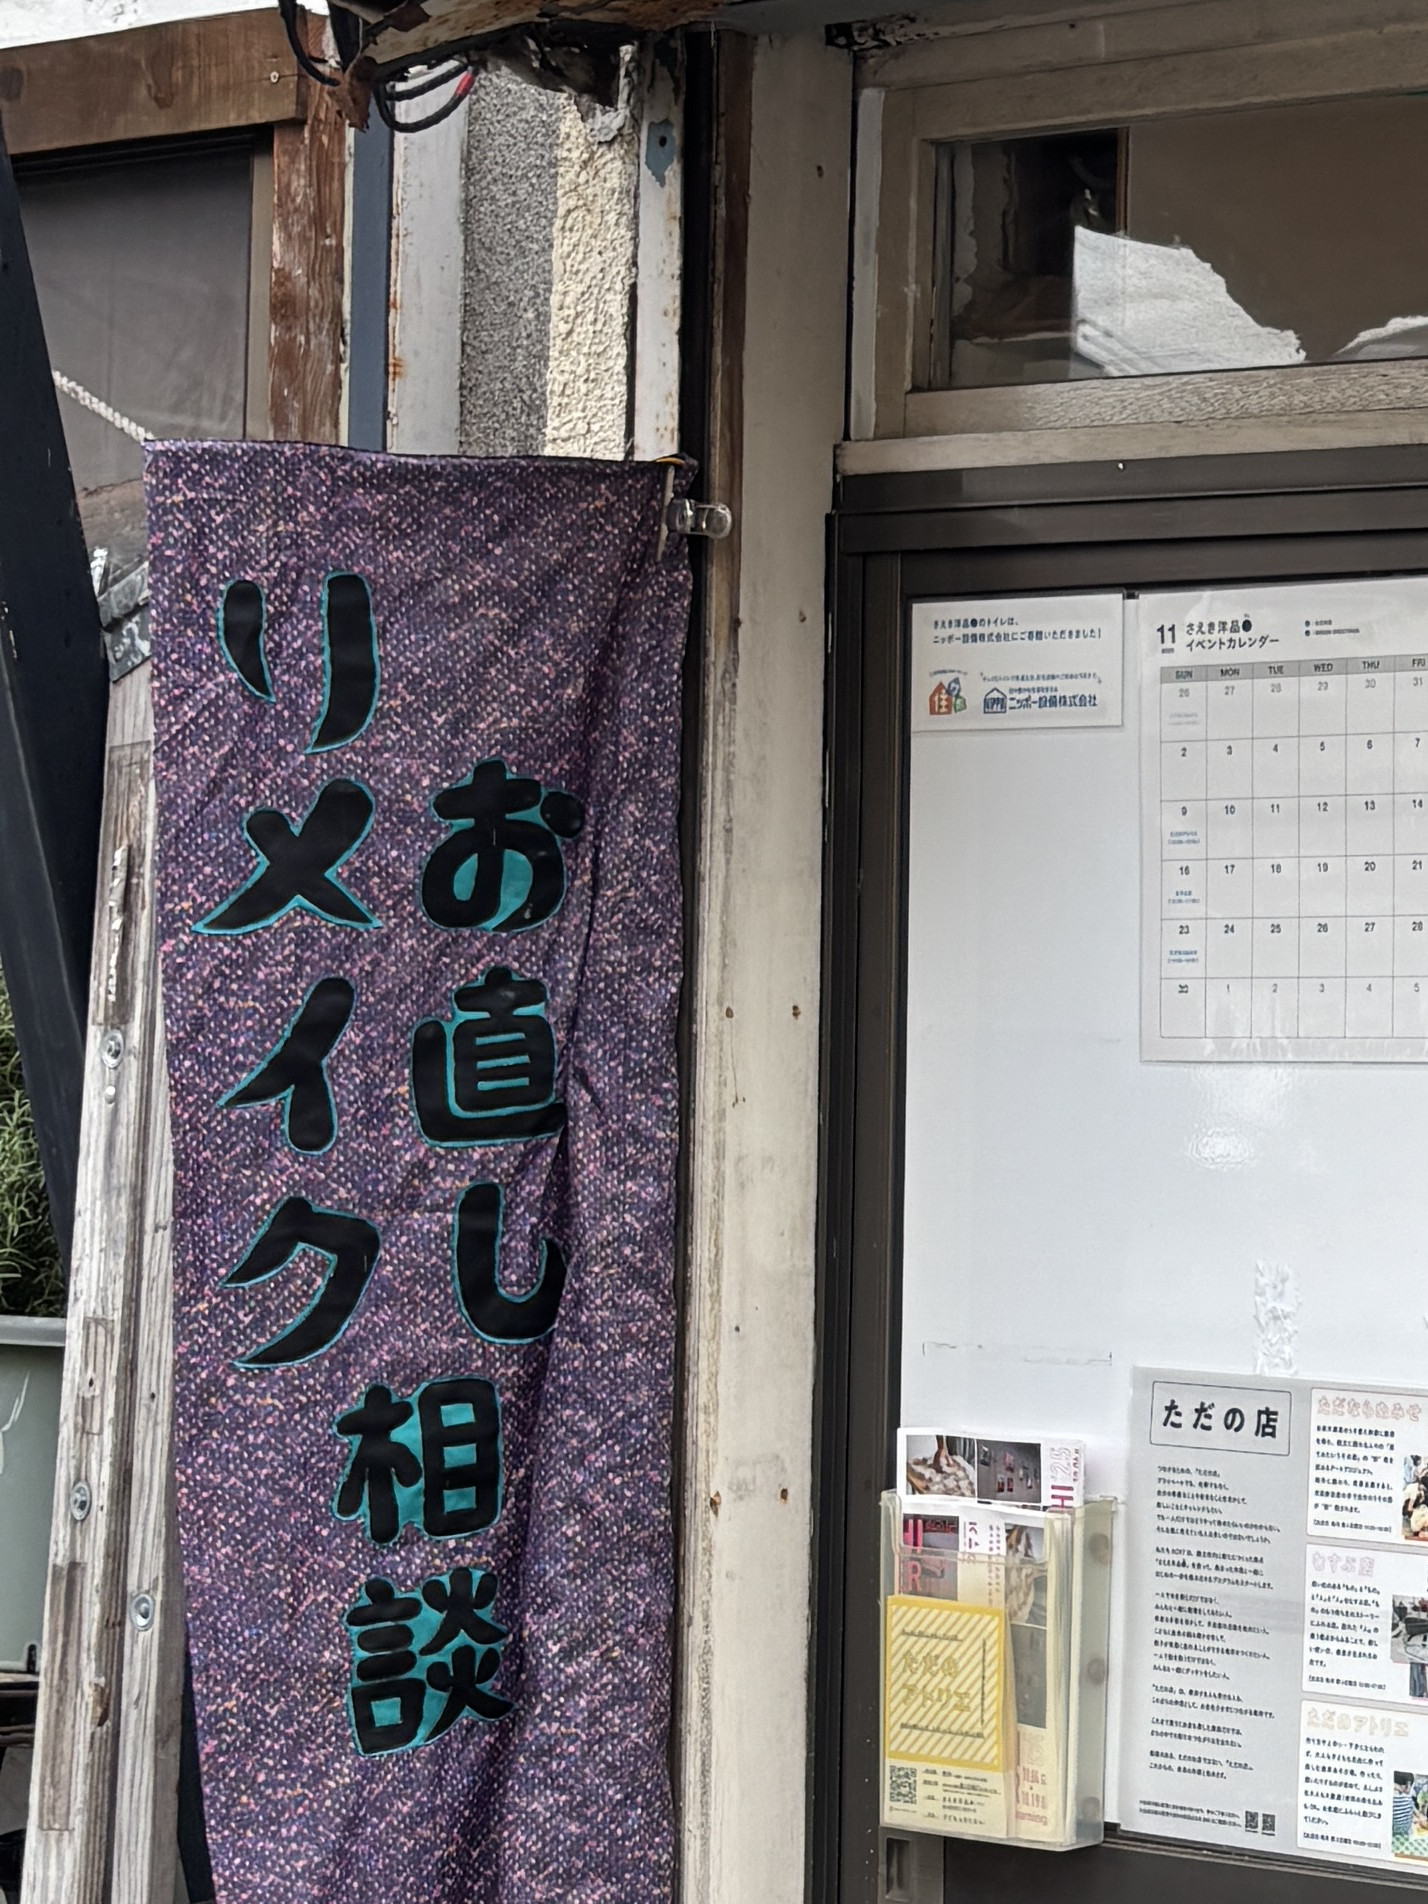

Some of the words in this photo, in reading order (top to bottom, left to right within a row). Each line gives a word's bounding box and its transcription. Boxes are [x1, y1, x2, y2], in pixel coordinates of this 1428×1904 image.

[1156, 624, 1176, 644] 11
[1186, 635, 1279, 650] イベントカレンダー
[1175, 670, 1193, 680] SUN
[1220, 667, 1240, 677] MON
[1268, 665, 1284, 675] TUE
[1313, 663, 1334, 672] WED
[1362, 660, 1380, 670] THU
[1411, 658, 1426, 667] FRI
[1224, 805, 1236, 814] 10
[1270, 803, 1280, 813] 11
[1317, 802, 1329, 811] 12
[1364, 801, 1376, 810] 13
[1412, 799, 1423, 809] 14
[1179, 866, 1190, 875] 16
[1224, 864, 1236, 874] 17
[1270, 864, 1282, 873] 18
[1317, 863, 1329, 872] 19
[1364, 862, 1376, 871] 20
[1412, 860, 1423, 870] 21
[1178, 925, 1190, 934] 23
[1223, 924, 1235, 933] 24
[1270, 924, 1282, 933] 25
[1317, 923, 1329, 932] 26
[1364, 922, 1376, 932] 27
[1411, 921, 1423, 931] 28
[192, 570, 382, 1370] リメイク
[332, 758, 585, 1760] お直し相談
[1161, 1398, 1279, 1439] ただの店
